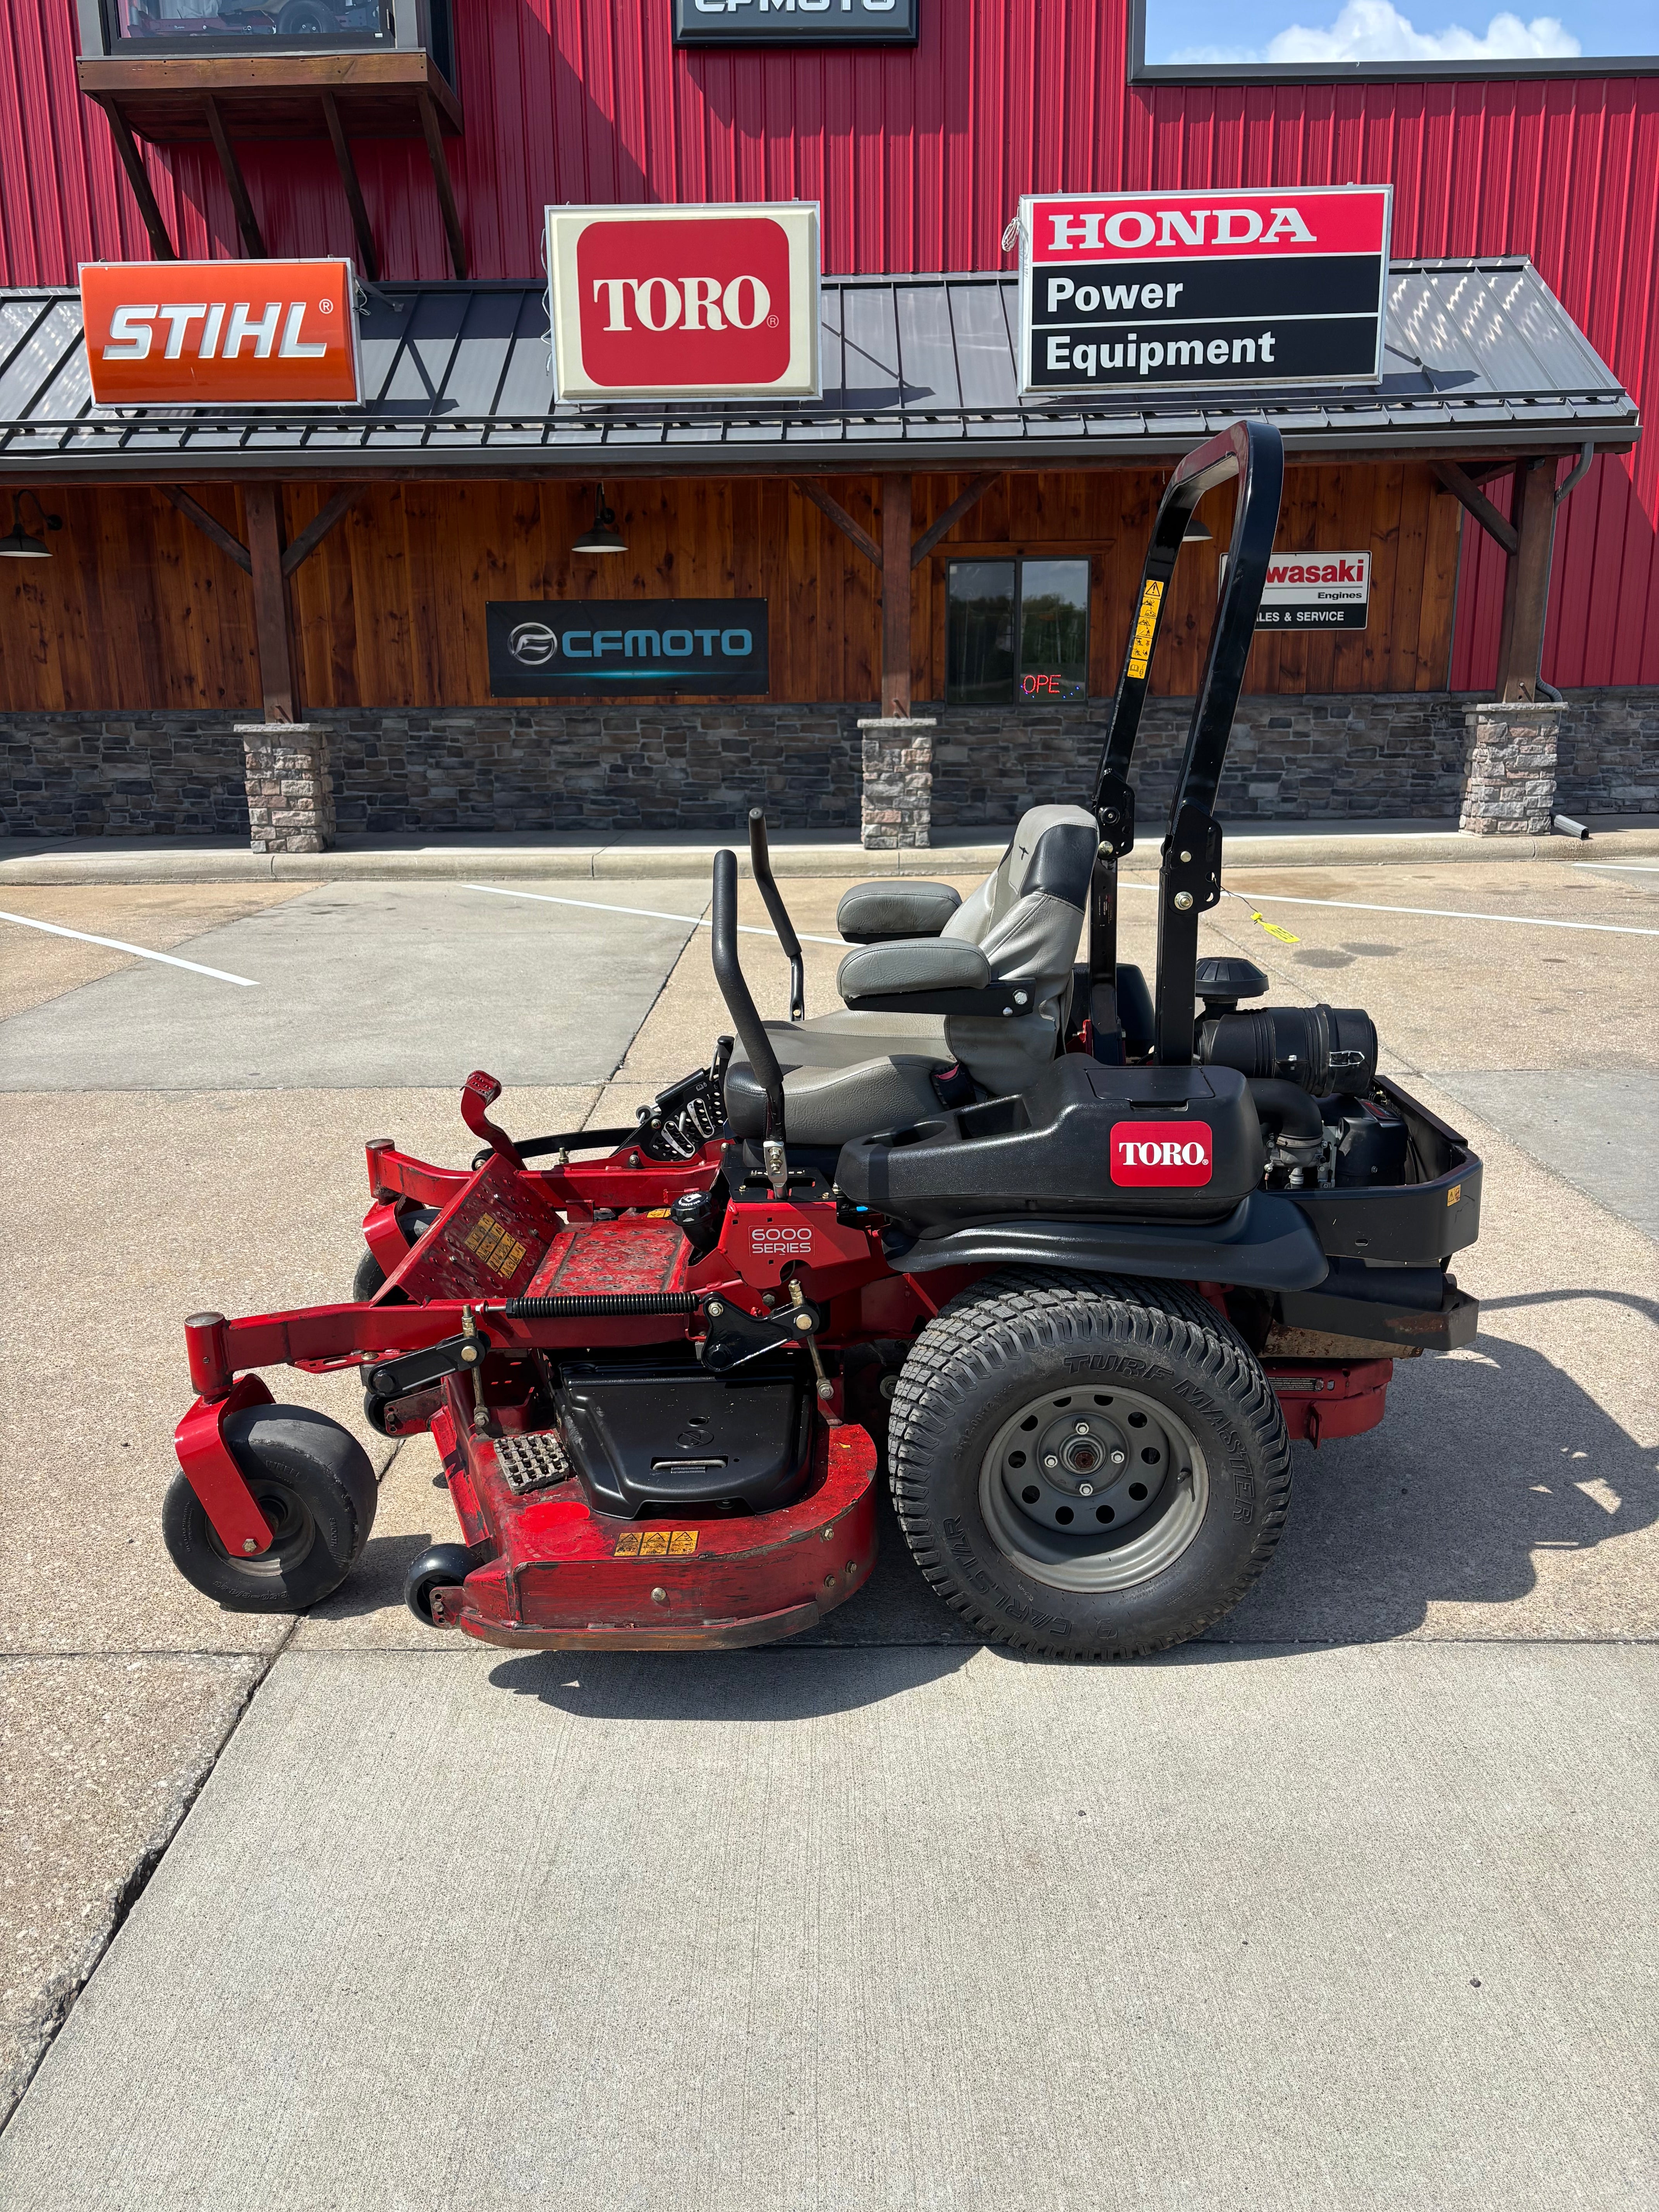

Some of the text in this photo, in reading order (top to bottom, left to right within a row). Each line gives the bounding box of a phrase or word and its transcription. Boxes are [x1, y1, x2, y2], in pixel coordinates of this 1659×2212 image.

[1048, 208, 1317, 251] HONDA
[1047, 277, 1183, 313] Power
[1046, 331, 1276, 377] Equipment
[1266, 559, 1364, 583] wasaki
[1317, 592, 1362, 600] Engines
[1257, 611, 1345, 622] LES & SERVICE
[562, 629, 752, 658] CFMOTO
[752, 1228, 812, 1241] 6000
[752, 1242, 811, 1254] SERIES
[1063, 1354, 1255, 1524] TURF MASTER
[943, 1515, 1072, 1637] CARLSTAR
